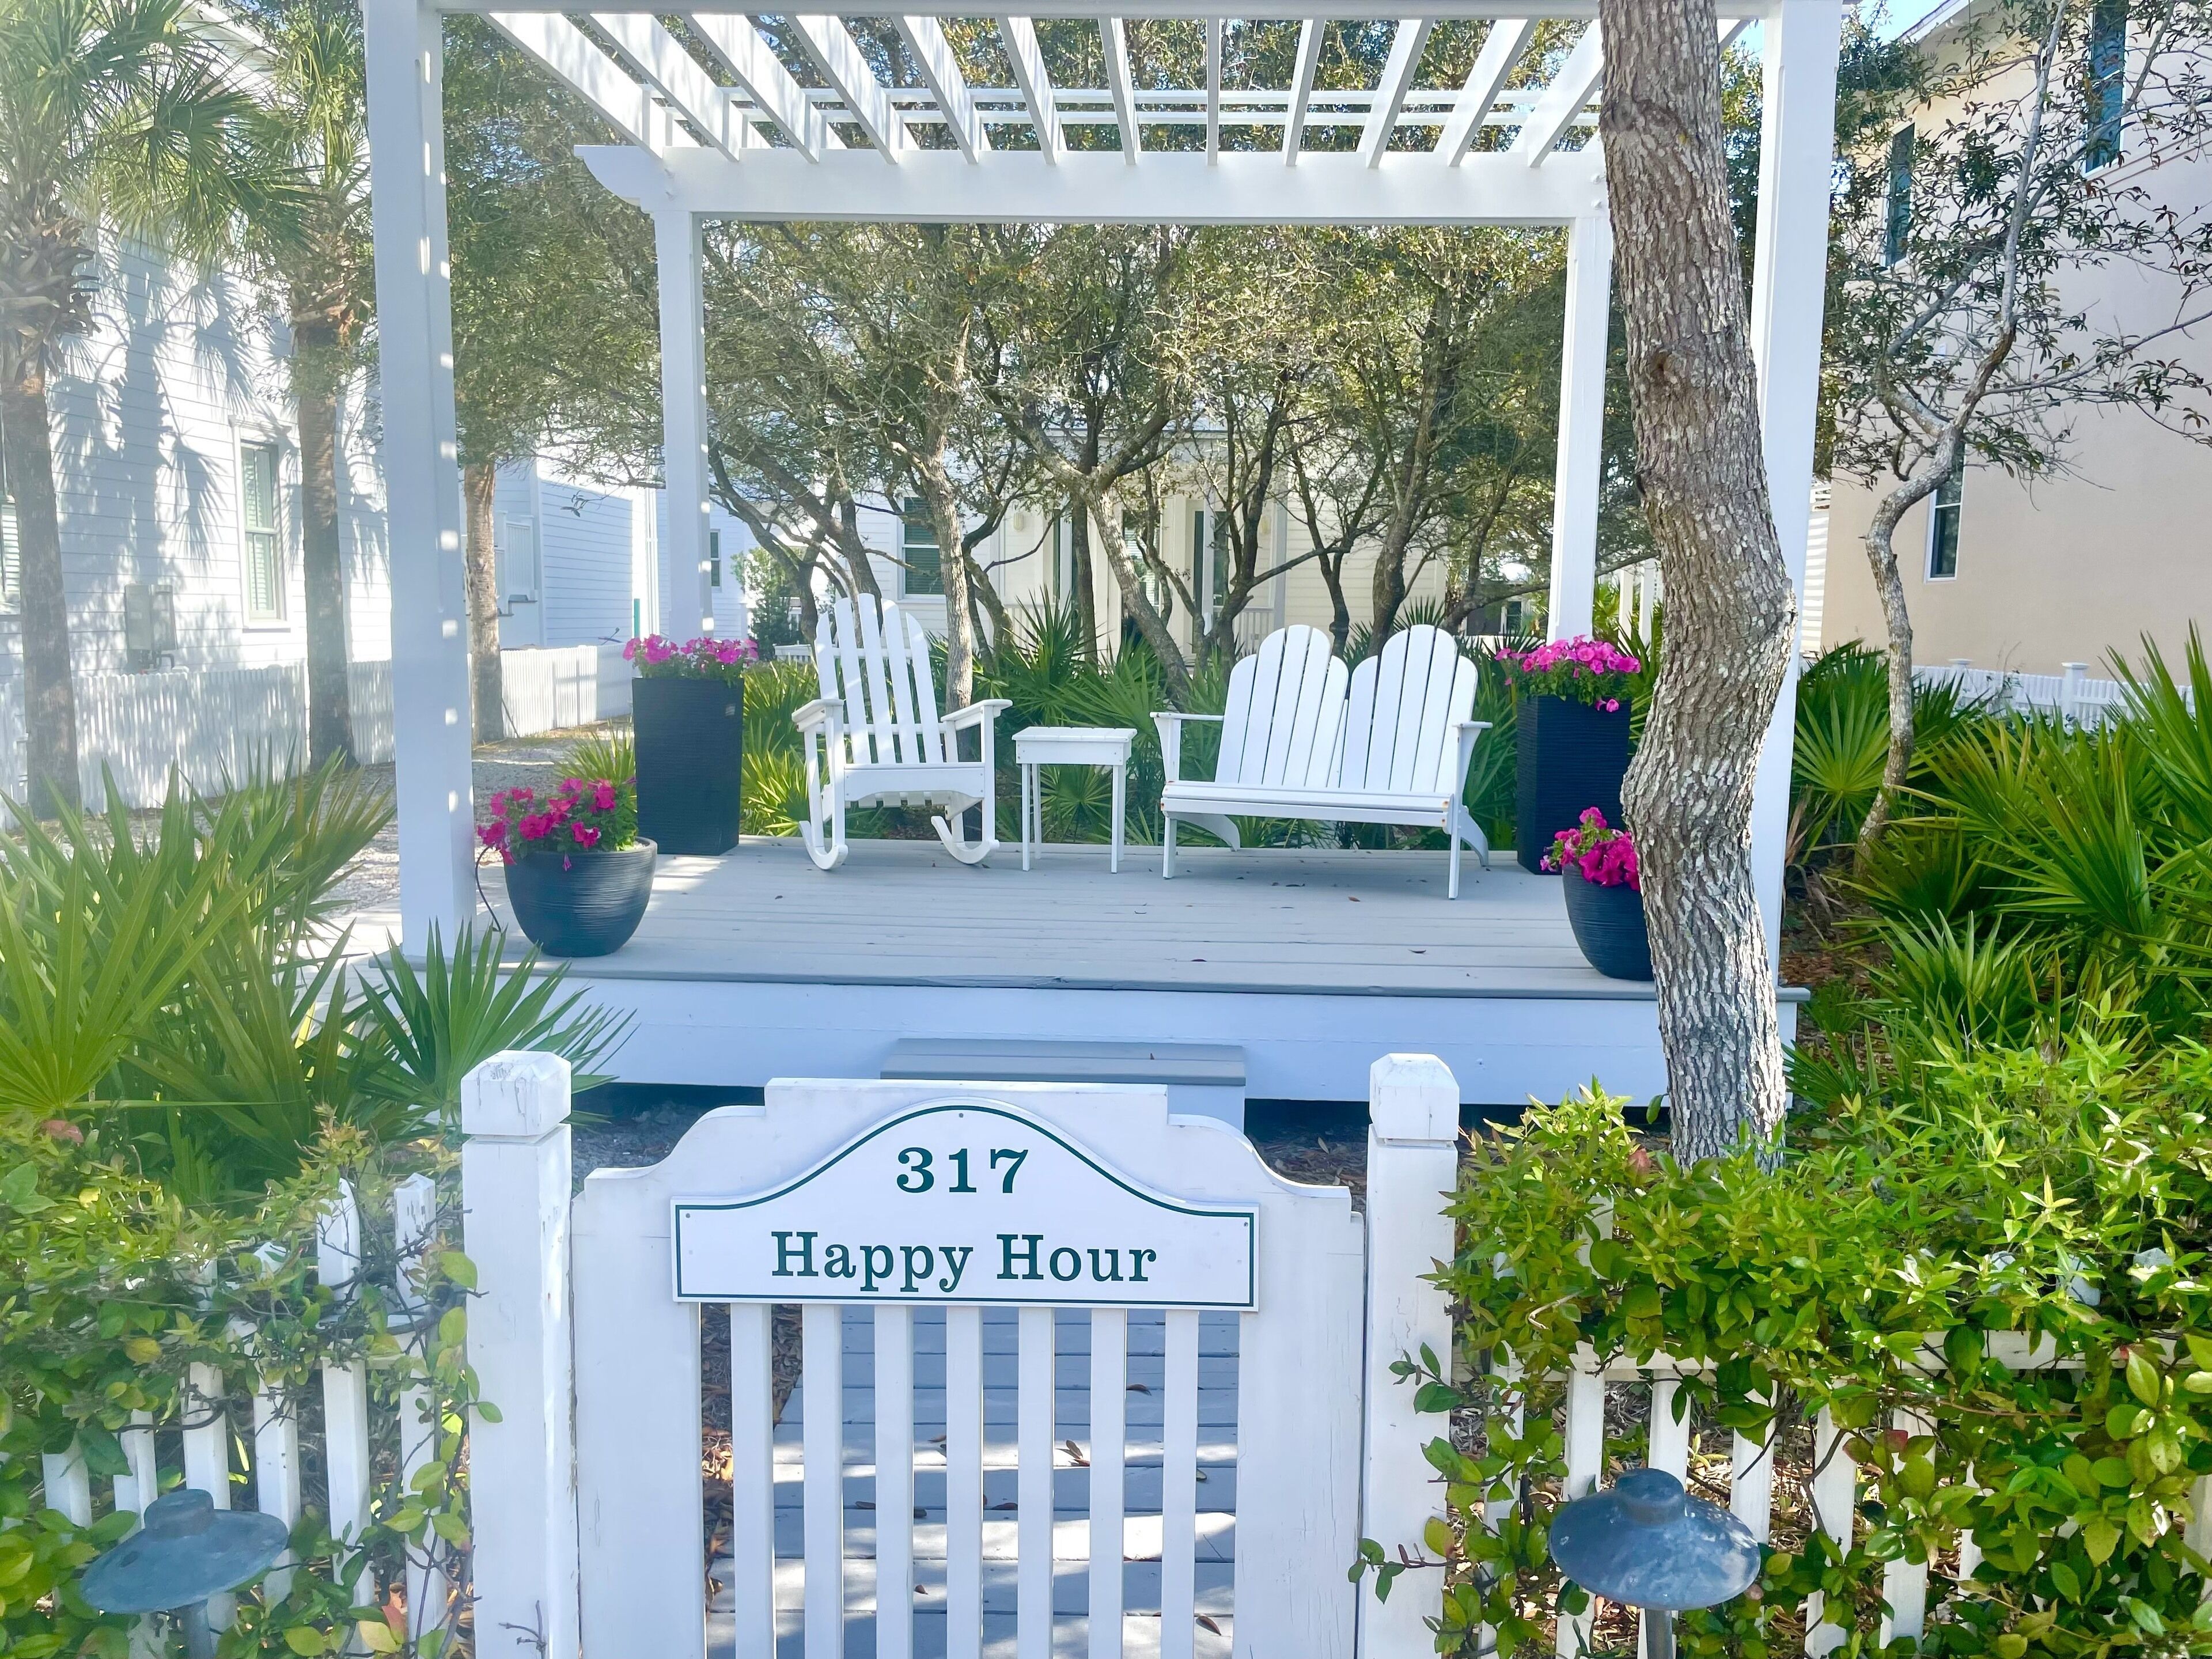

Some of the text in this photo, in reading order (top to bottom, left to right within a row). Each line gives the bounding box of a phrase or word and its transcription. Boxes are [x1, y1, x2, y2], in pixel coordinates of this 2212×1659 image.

[896, 1147, 1029, 1194] 317
[771, 1231, 1157, 1293] Happy Hour
